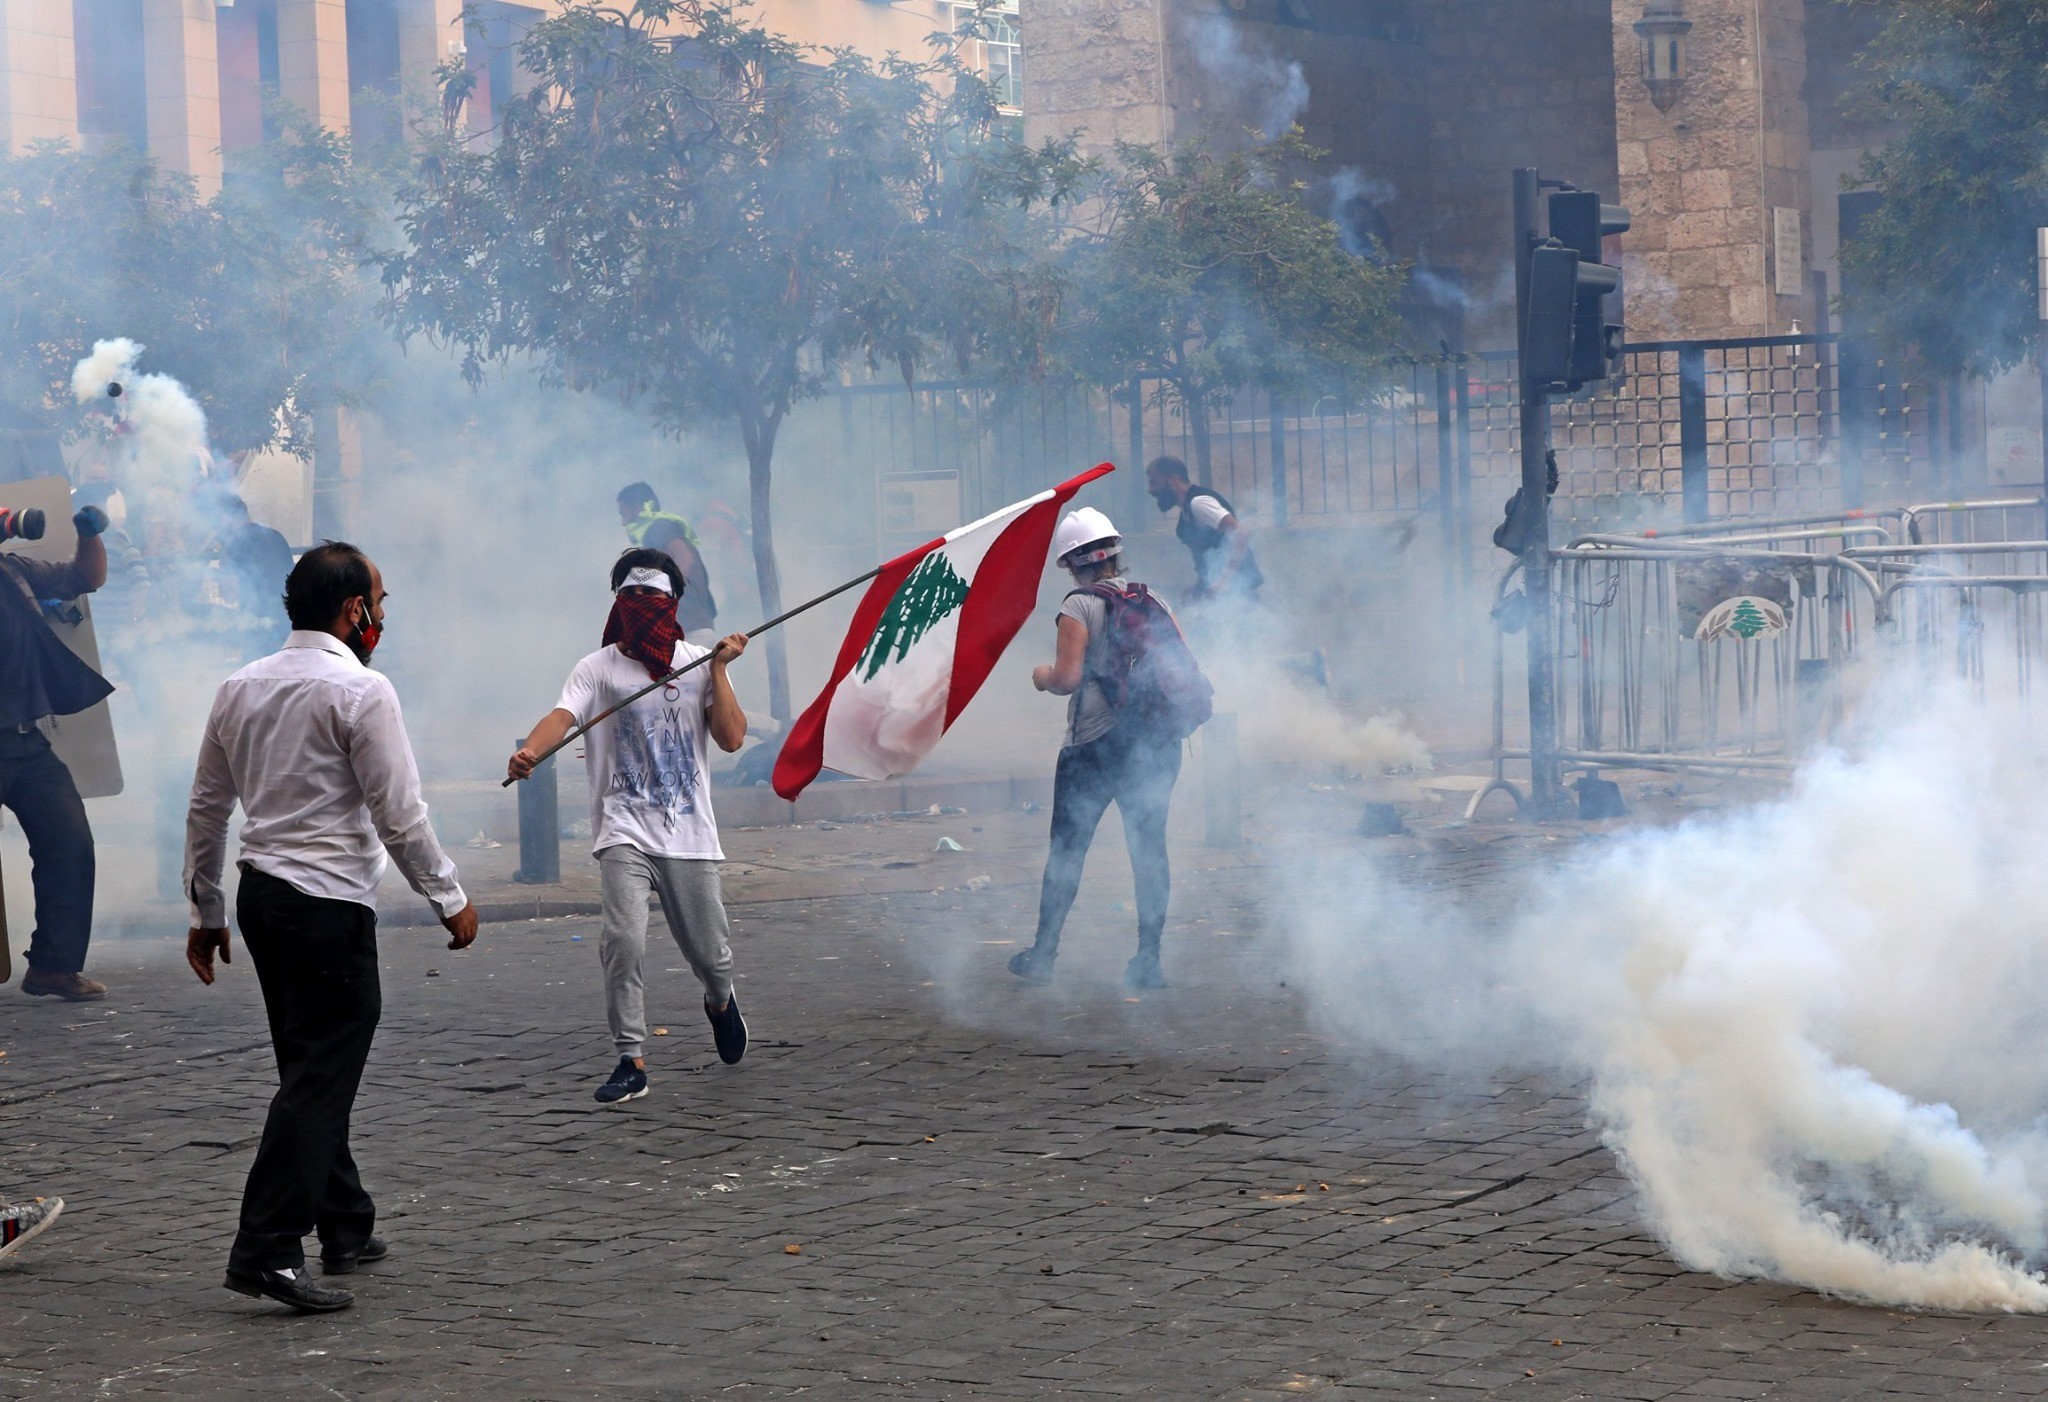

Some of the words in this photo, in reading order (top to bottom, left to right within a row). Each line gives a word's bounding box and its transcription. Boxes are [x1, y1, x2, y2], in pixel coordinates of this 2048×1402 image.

[611, 772, 649, 789] NEW
[654, 770, 700, 788] YORK
[662, 686, 681, 828] OWNTOWN
